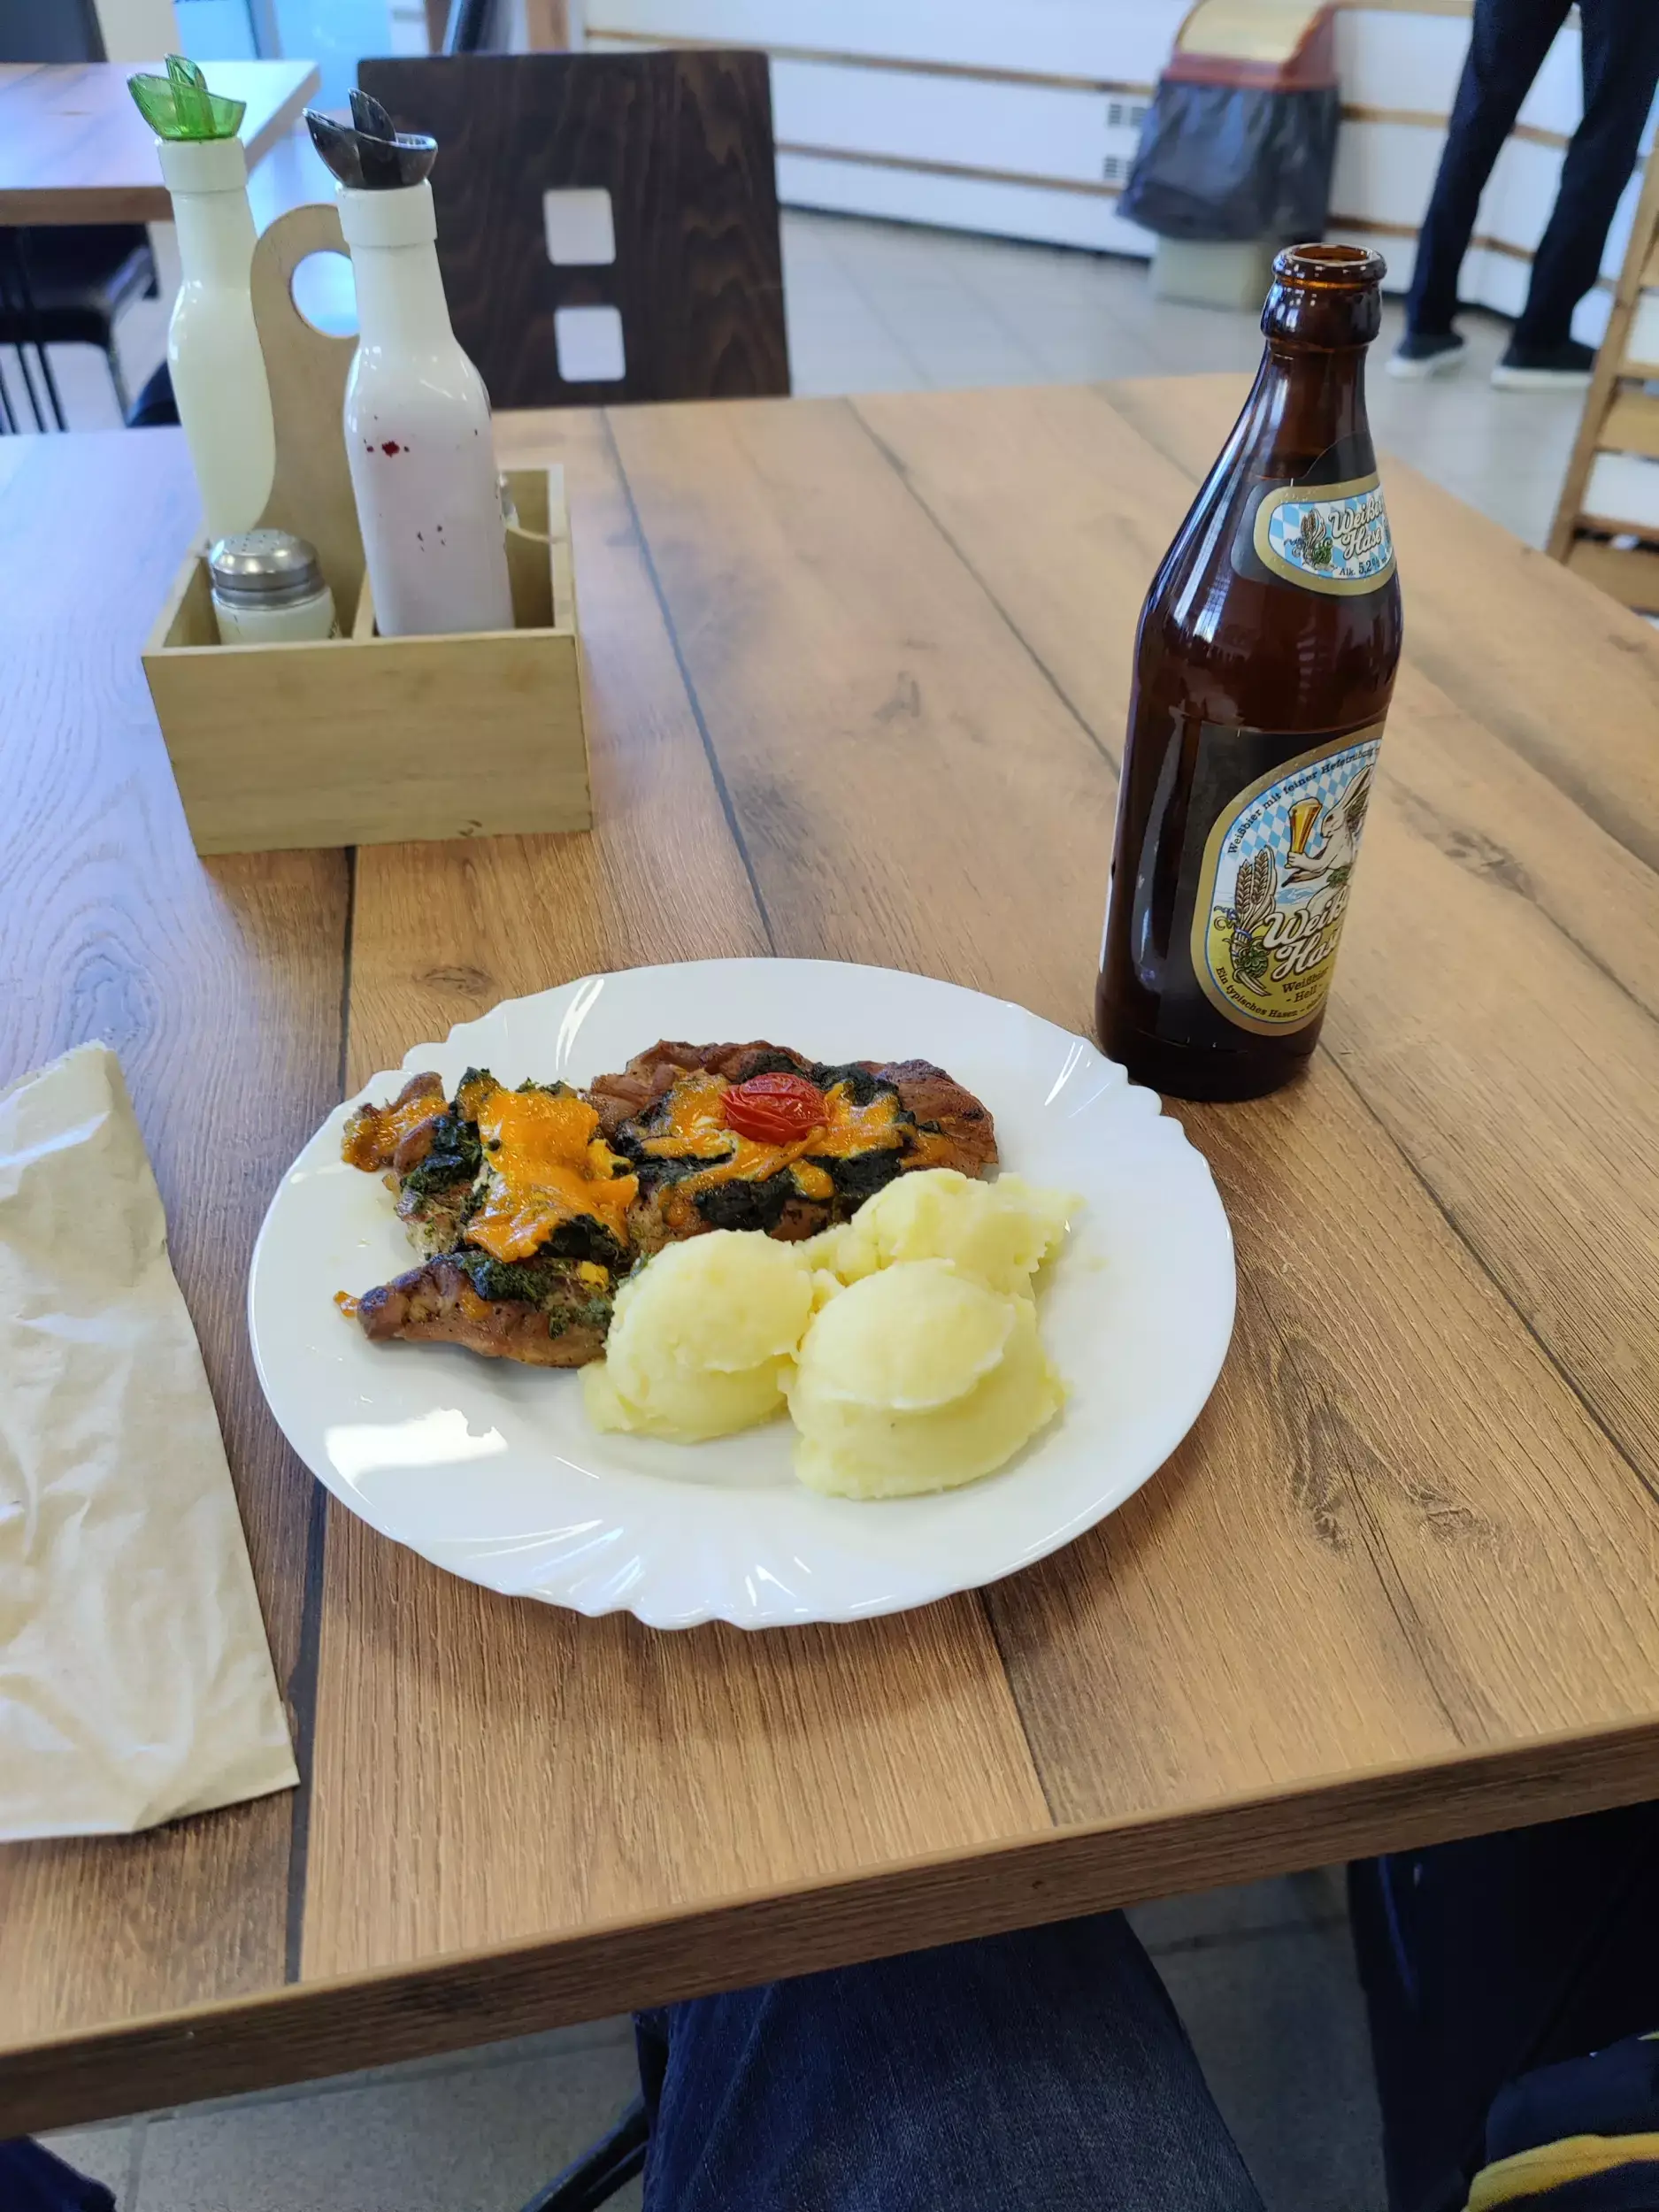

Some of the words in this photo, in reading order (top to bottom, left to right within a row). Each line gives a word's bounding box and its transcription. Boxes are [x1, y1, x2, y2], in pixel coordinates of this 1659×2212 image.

[1341, 526, 1382, 560] Hase
[1227, 809, 1262, 854] Weißbier
[1263, 792, 1282, 810] mit
[1283, 771, 1318, 795] feiner
[1217, 966, 1229, 985] Ein
[1225, 984, 1267, 1016] typisches
[1268, 1009, 1298, 1018] Hasen
